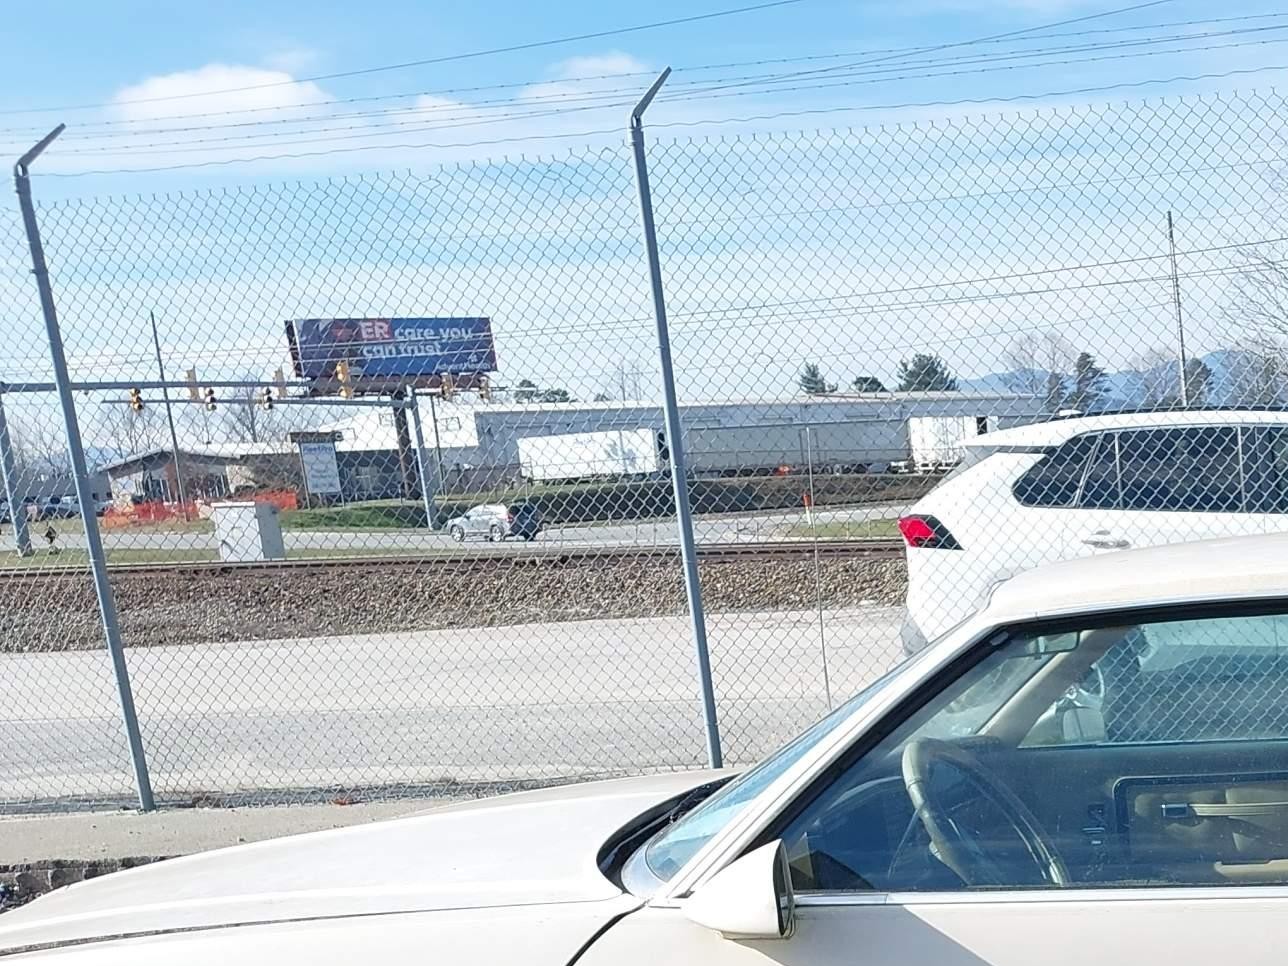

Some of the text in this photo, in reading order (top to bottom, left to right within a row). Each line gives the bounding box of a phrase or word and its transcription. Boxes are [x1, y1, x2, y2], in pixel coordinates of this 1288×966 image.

[359, 321, 473, 343] ER care you
[363, 341, 442, 358] can trust
